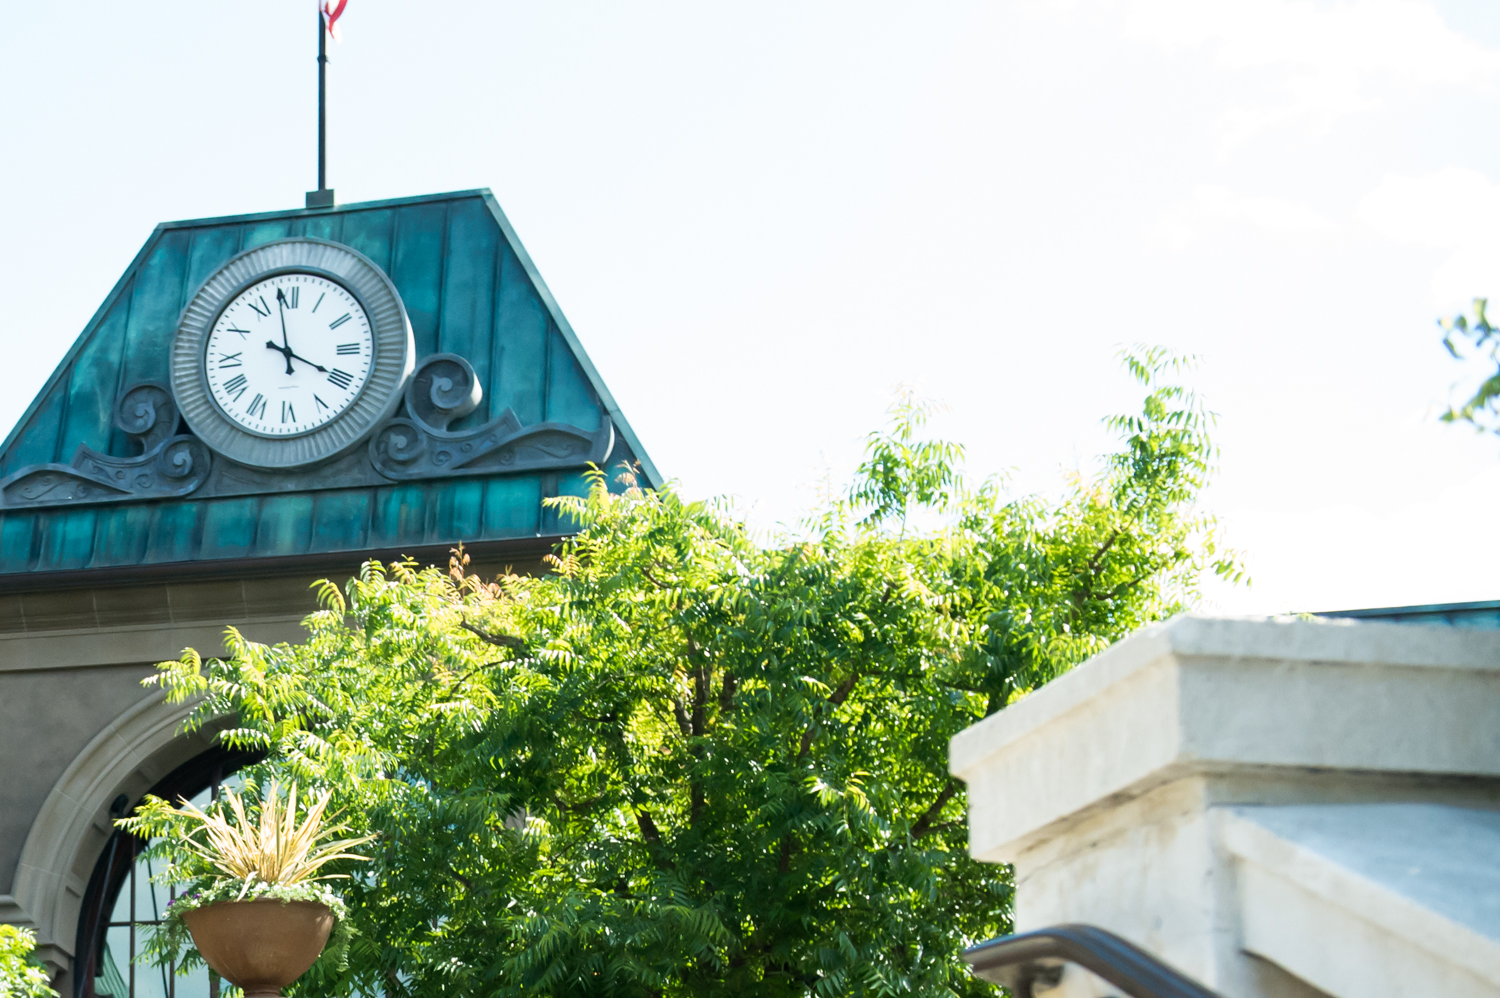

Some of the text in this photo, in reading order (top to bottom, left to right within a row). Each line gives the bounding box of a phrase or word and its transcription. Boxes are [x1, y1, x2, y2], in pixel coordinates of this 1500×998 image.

[226, 321, 251, 341] X
[328, 312, 353, 331] II
[336, 342, 361, 356] III
[218, 351, 243, 370] IX
[281, 400, 297, 424] VI
[313, 393, 329, 415] V
